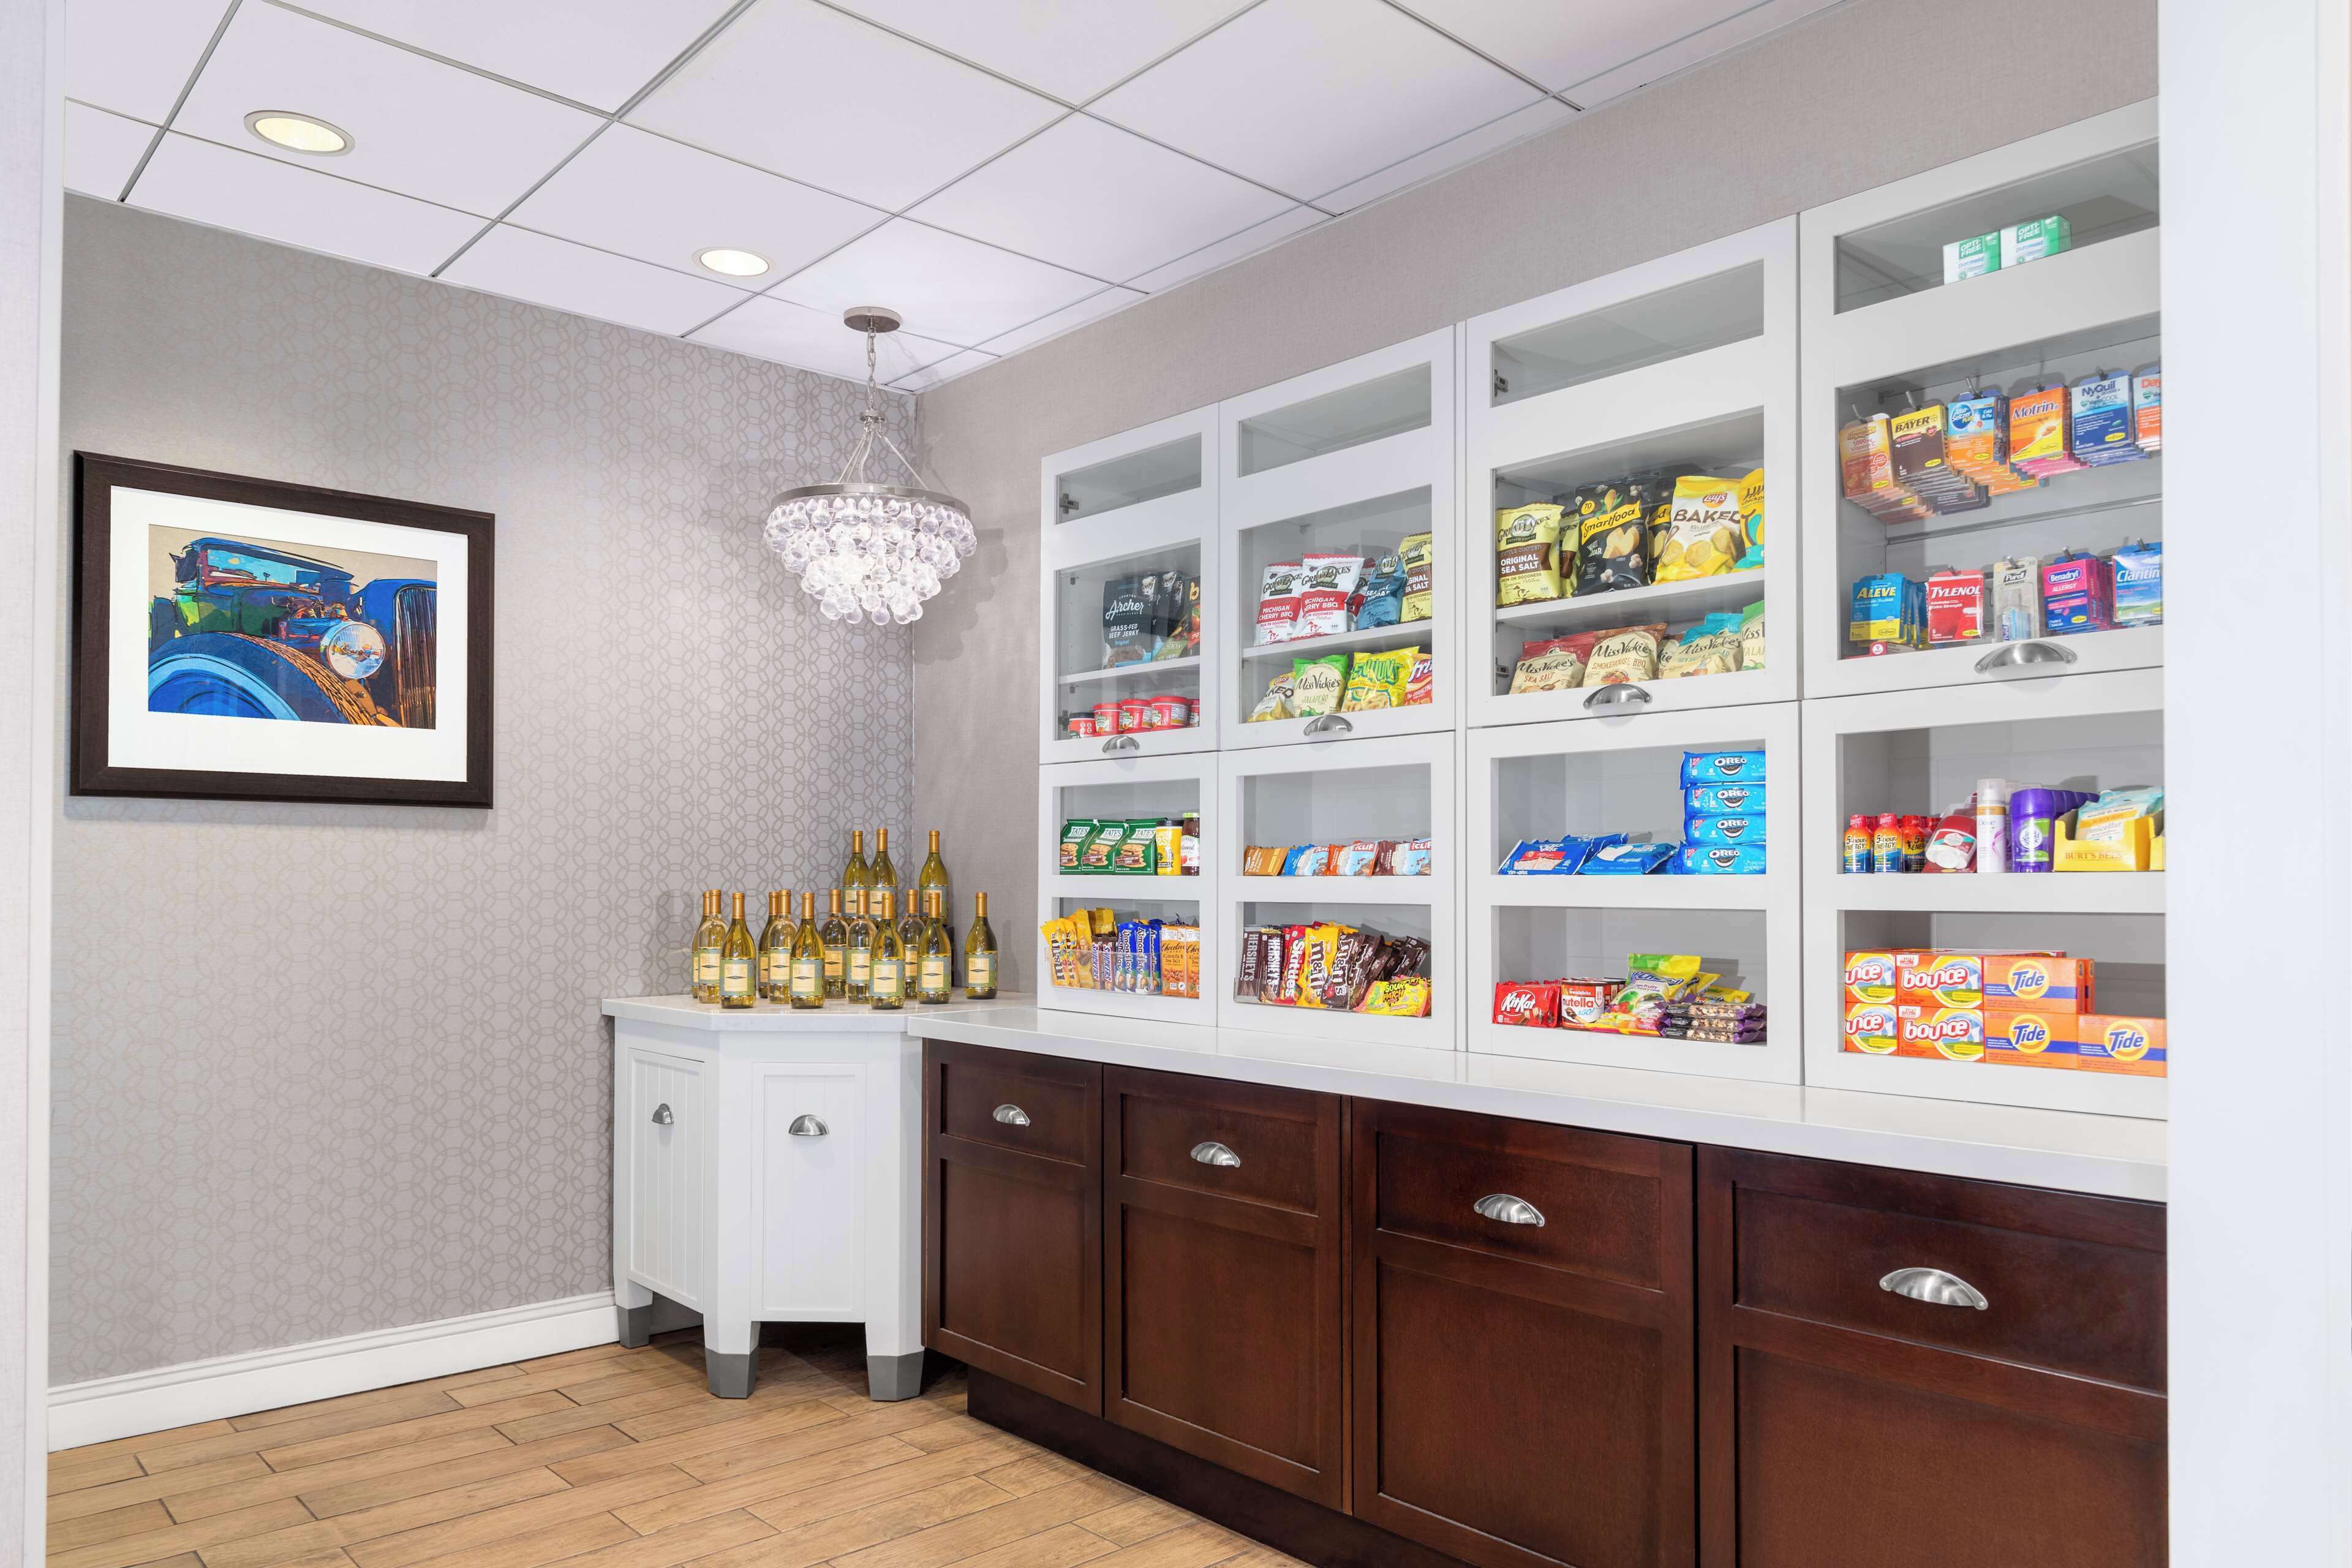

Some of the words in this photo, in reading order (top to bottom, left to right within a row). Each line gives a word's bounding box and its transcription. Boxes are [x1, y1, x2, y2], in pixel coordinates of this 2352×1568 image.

[2018, 221, 2040, 236] OPTI-
[2019, 227, 2040, 241] FREE
[1961, 238, 1981, 251] OPTI-
[1961, 244, 1981, 257] FREE
[2082, 380, 2116, 397] NyQuil
[2011, 401, 2054, 421] Motrin
[1895, 416, 1930, 433] BAYER
[1583, 508, 1635, 538] Smartfood
[1501, 554, 1539, 565] ORIGINAL
[1519, 561, 1539, 571] SALT
[1408, 575, 1428, 585] GINAL
[2050, 570, 2079, 582] Benadryl
[2116, 567, 2160, 582] Claritin
[1412, 581, 1429, 591] SALT
[1856, 586, 1897, 600] ALEVE
[1931, 586, 1981, 600] TYLENOL
[2052, 582, 2078, 592] ALLERGY
[1105, 598, 1145, 621] Archer
[1262, 605, 1290, 613] MICHIGAN
[1110, 623, 1138, 633] GRASS-FED
[1122, 629, 1140, 638] JERKY
[1593, 644, 1622, 658] Miss
[1679, 643, 1710, 655] Miss
[1709, 636, 1742, 650] Vickie's
[1516, 662, 1542, 674] Miss
[1541, 658, 1577, 671] Vickie's
[1593, 658, 1631, 670] SMOKEHOUSE
[1633, 658, 1646, 670] BBQ
[1295, 677, 1314, 691] Miss
[1313, 672, 1341, 692] Vickie's
[1539, 672, 1555, 682] SALT
[1302, 693, 1329, 704] JALAPEÑO
[1714, 756, 1747, 766] OREO
[1717, 789, 1749, 800] OREO
[1716, 819, 1749, 829] OREO
[1846, 835, 1867, 845] 5-hour
[1876, 834, 1897, 843] 5-hour
[1708, 848, 1740, 859] OREO
[1845, 843, 1865, 851] ENERGY
[1122, 929, 1133, 958] Almond
[1137, 927, 1147, 959] Almond
[1103, 944, 1112, 982] SNICKERS
[1243, 933, 1259, 982] HERSHEY'S
[1124, 957, 1133, 974] Joy
[1137, 959, 1148, 974] Joy
[1285, 940, 1305, 998] Skittles
[1310, 940, 1325, 999] m&m's
[1332, 938, 1354, 996] m&m's
[1845, 964, 1883, 987] unce
[1903, 968, 1968, 991] bounce
[2011, 970, 2045, 993] Tide
[1384, 982, 1406, 993] SOUR
[1383, 989, 1405, 1003] PATCH
[1562, 997, 1594, 1008] nutella
[1845, 1014, 1885, 1036] unce
[1904, 1019, 1970, 1042] bounce
[2013, 1024, 2046, 1047] Tide
[2108, 1030, 2144, 1053] Tide
